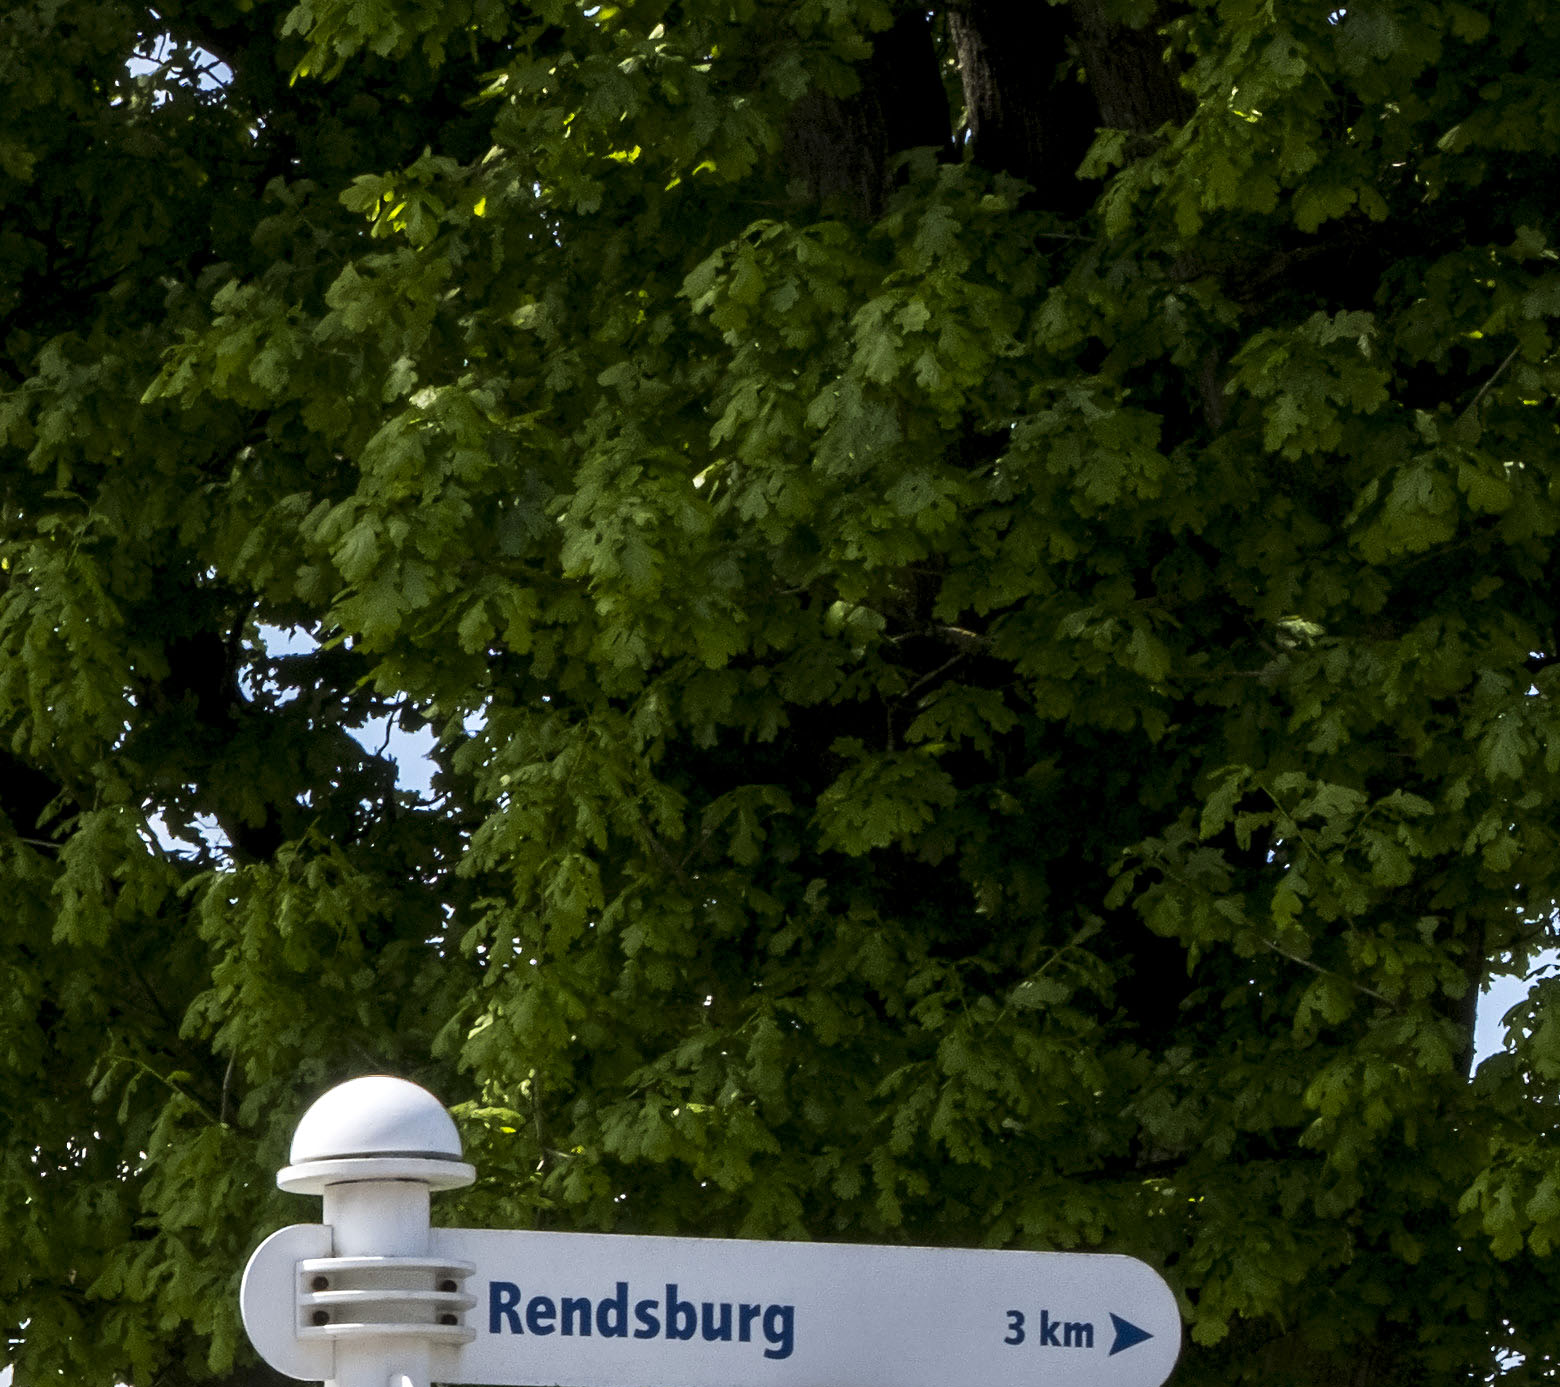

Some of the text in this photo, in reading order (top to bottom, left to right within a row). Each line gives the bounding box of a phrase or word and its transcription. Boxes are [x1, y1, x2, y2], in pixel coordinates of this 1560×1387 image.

[488, 1281, 1094, 1359] Rendsburg 3 km
